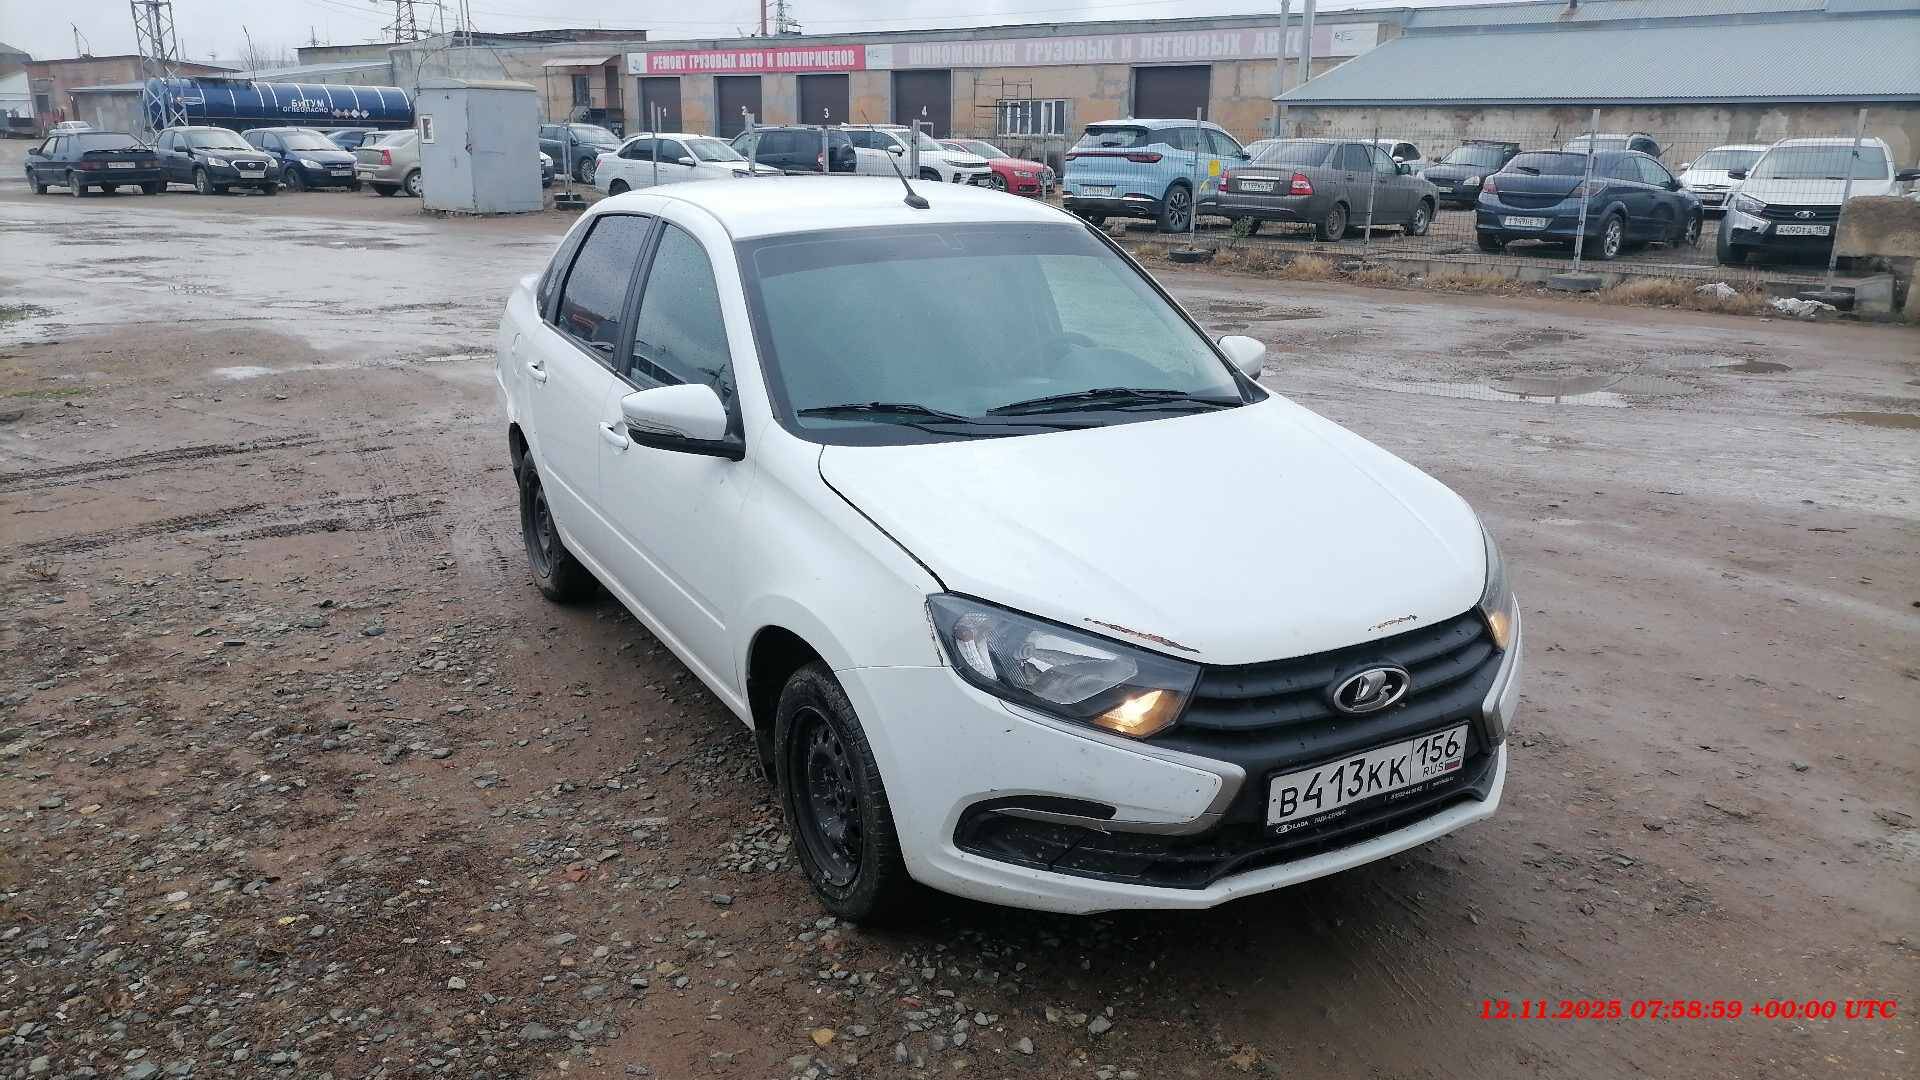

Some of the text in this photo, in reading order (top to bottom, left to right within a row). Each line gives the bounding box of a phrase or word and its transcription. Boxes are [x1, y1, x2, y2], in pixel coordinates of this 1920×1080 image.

[909, 43, 1016, 65] ШИНОМОНТАЖ
[1024, 39, 1114, 63] ГРУЗОВЫХ
[1120, 36, 1132, 58] И
[1139, 33, 1241, 58] ЛЕГКОВЫХ
[653, 50, 855, 70] РЕМОНТ ГРУЗОВЫХ АВТО И ПОЛУПРИЦЕПОВ
[291, 99, 325, 108] БИТУМ
[662, 107, 667, 117] 1
[741, 105, 748, 115] 2
[824, 108, 830, 119] 3
[921, 105, 928, 117] 4
[1280, 730, 1460, 819] В413КК 156
[1422, 761, 1445, 778] RUS
